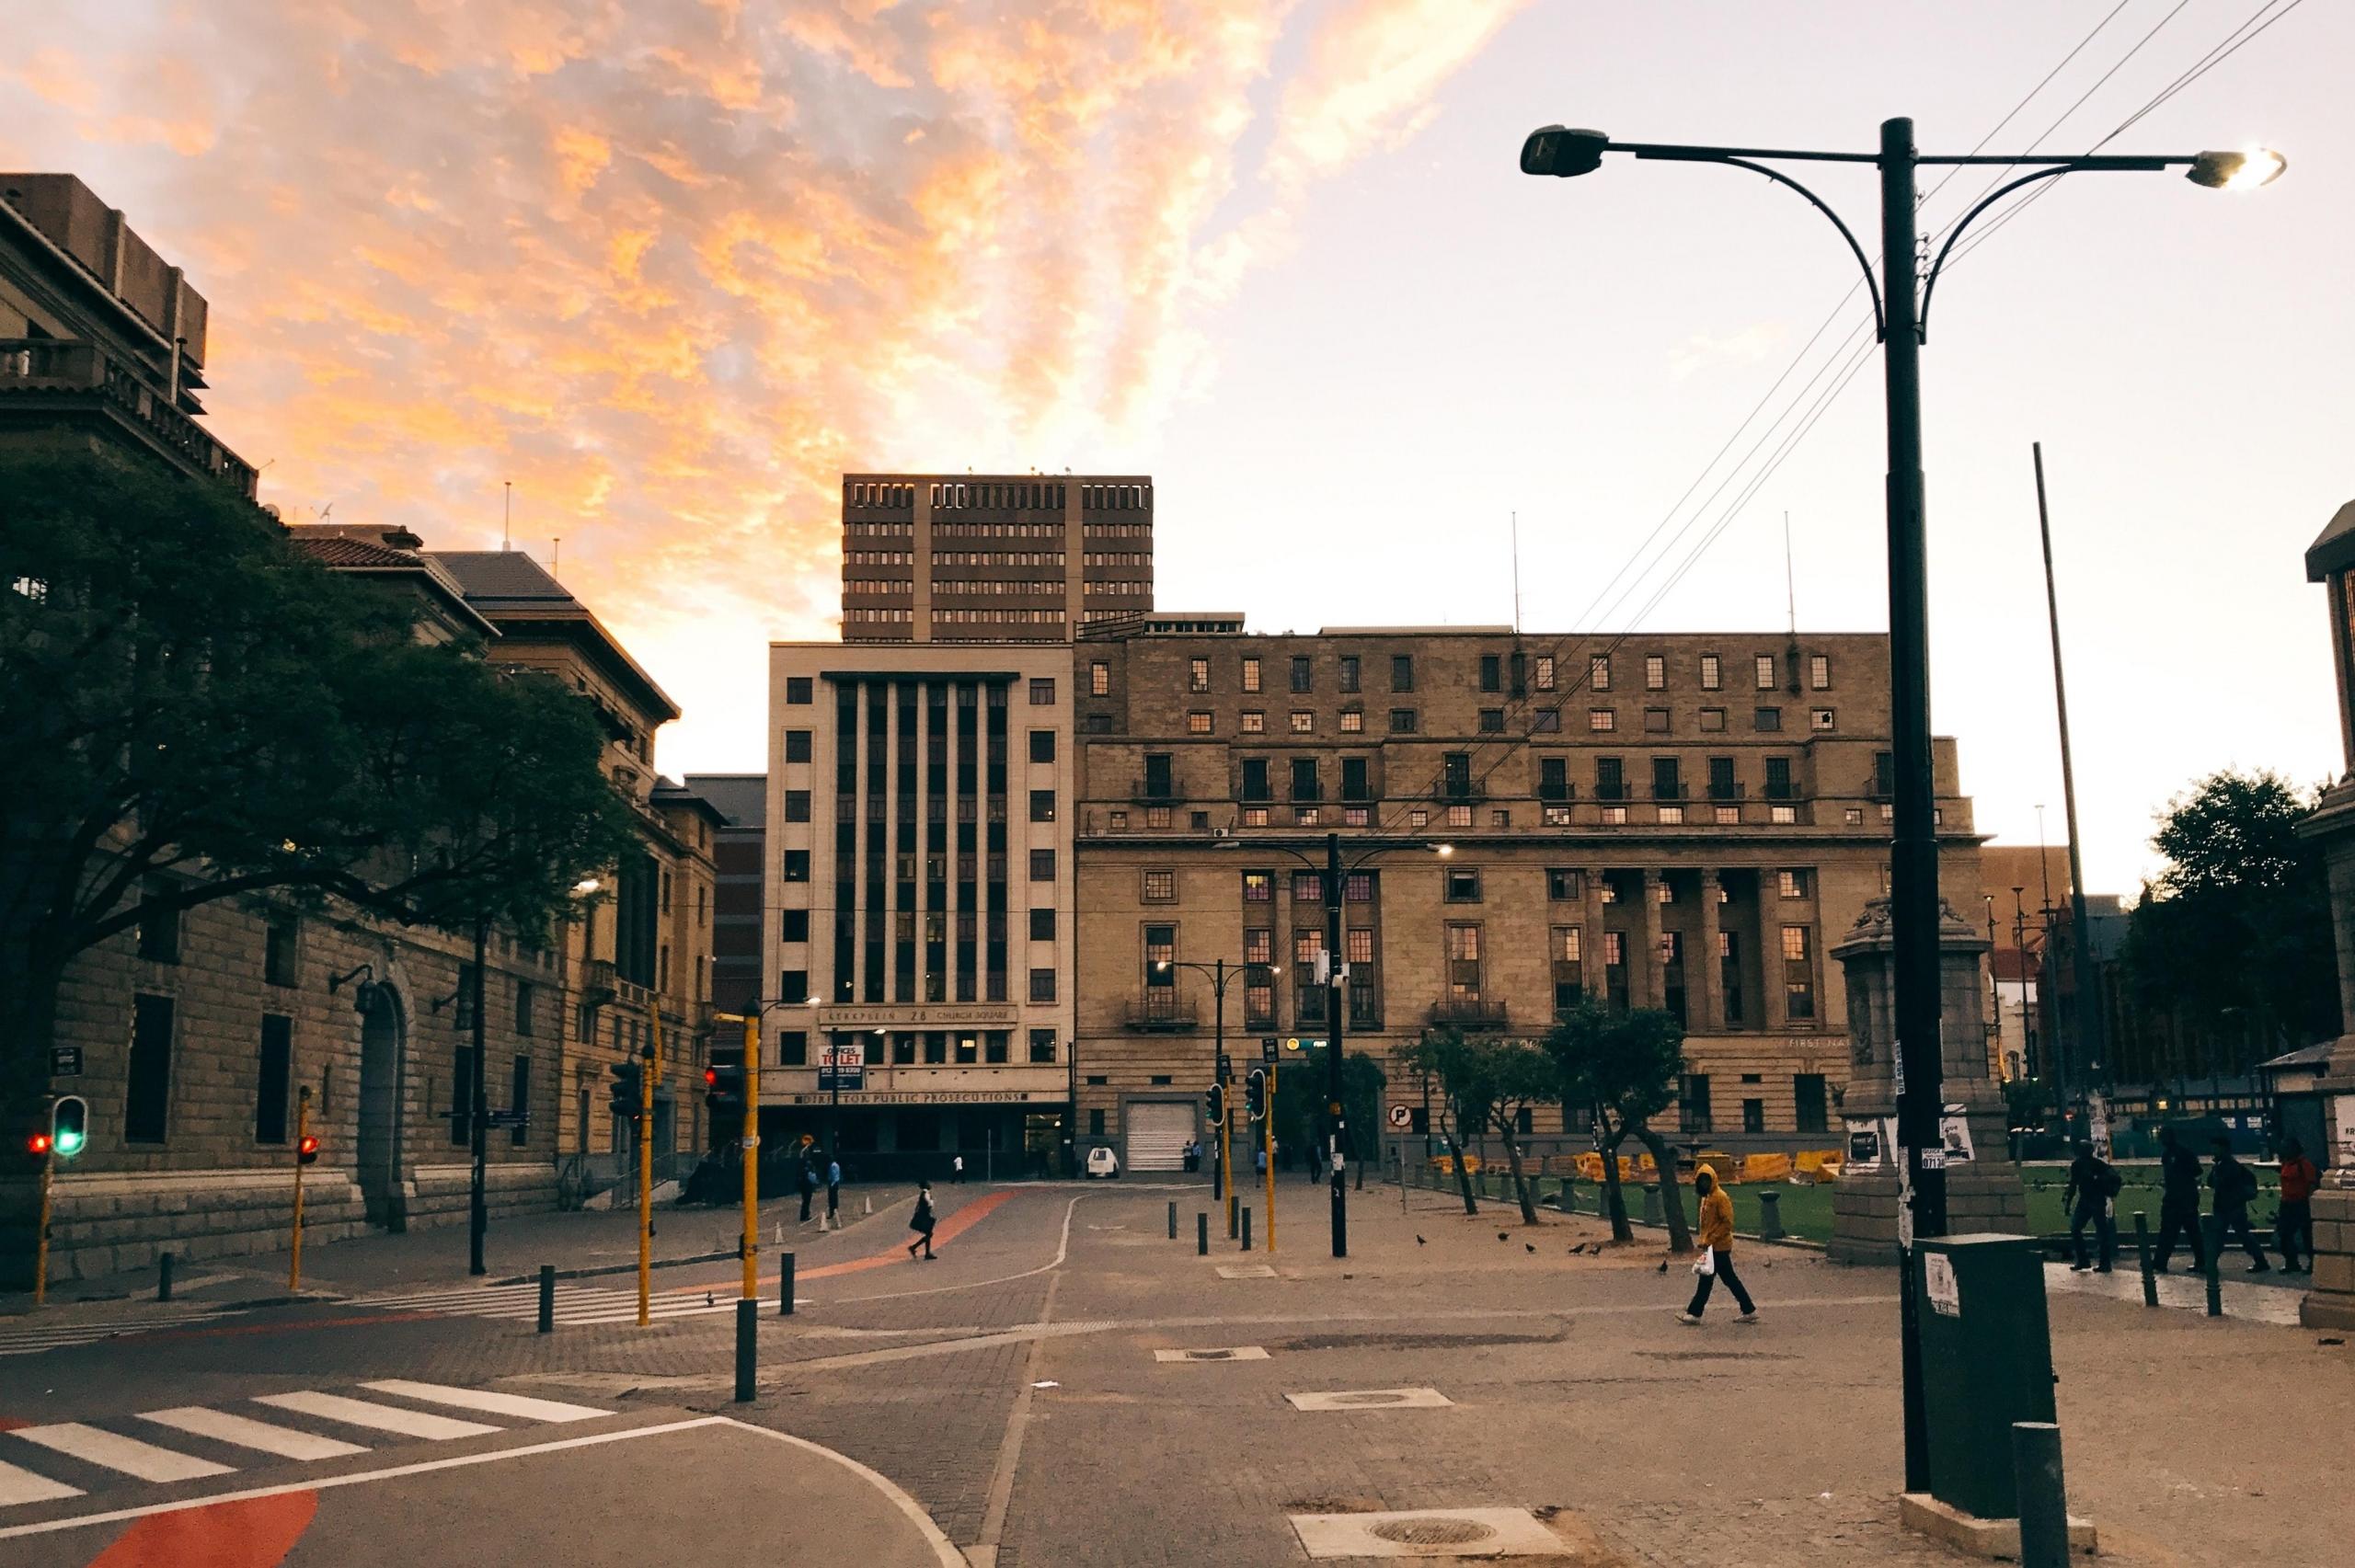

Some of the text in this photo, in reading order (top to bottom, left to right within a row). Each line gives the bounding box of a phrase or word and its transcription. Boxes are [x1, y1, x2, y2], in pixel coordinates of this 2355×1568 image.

[936, 1012, 972, 1020] CHURCH
[977, 1011, 1007, 1020] SQUARE
[1789, 1038, 1820, 1047] FIRST
[840, 1054, 861, 1065] LET
[803, 1093, 1019, 1104] DIRETOR PUBLIC PROSECUTIONS
